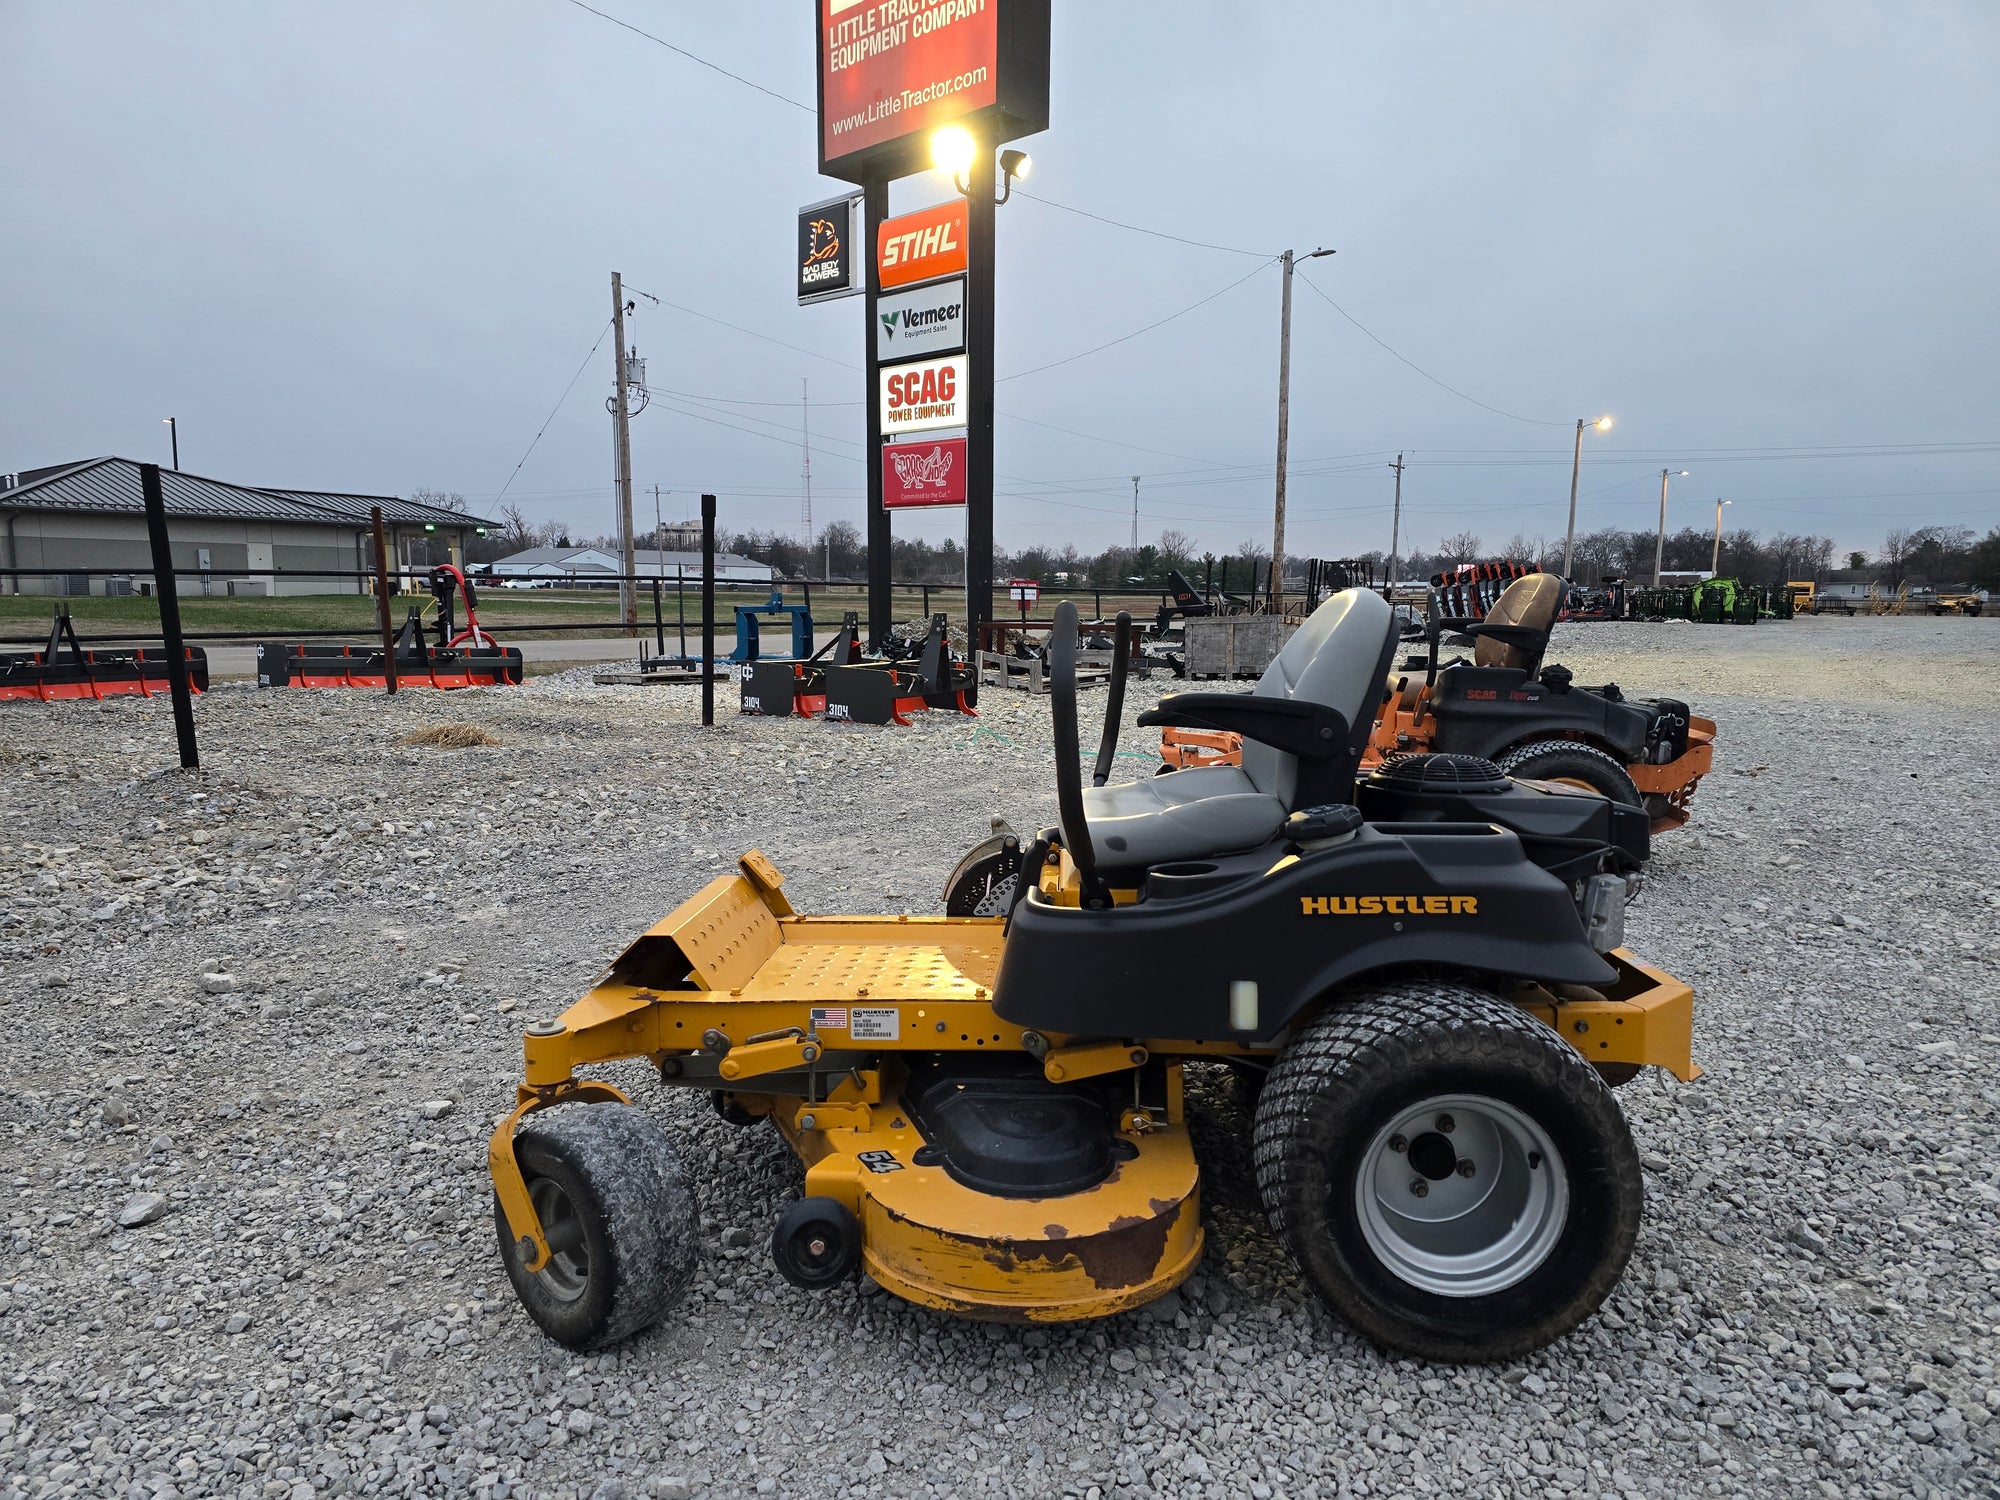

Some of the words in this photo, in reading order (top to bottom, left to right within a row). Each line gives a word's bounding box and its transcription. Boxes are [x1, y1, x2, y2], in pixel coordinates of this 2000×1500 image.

[830, 8, 876, 49] LITTLE
[831, 19, 909, 73] EQUIPMENT
[832, 65, 988, 136] www.LittleTractor.com
[882, 222, 957, 267] STIHL
[803, 264, 820, 275] BAD
[821, 259, 839, 271] BOY
[803, 268, 840, 284] MOWERS
[902, 303, 962, 329] Vermeer
[904, 328, 932, 339] Equipment
[932, 324, 948, 333] Sales
[888, 366, 956, 408] SCAG
[888, 408, 912, 423] POWER
[914, 402, 956, 420] EQUIPMENT
[744, 696, 760, 708] 3104
[1467, 689, 1497, 700] SCAG
[828, 703, 849, 717] 3104
[1301, 895, 1477, 915] HUSTLER
[860, 1151, 902, 1173] 54
